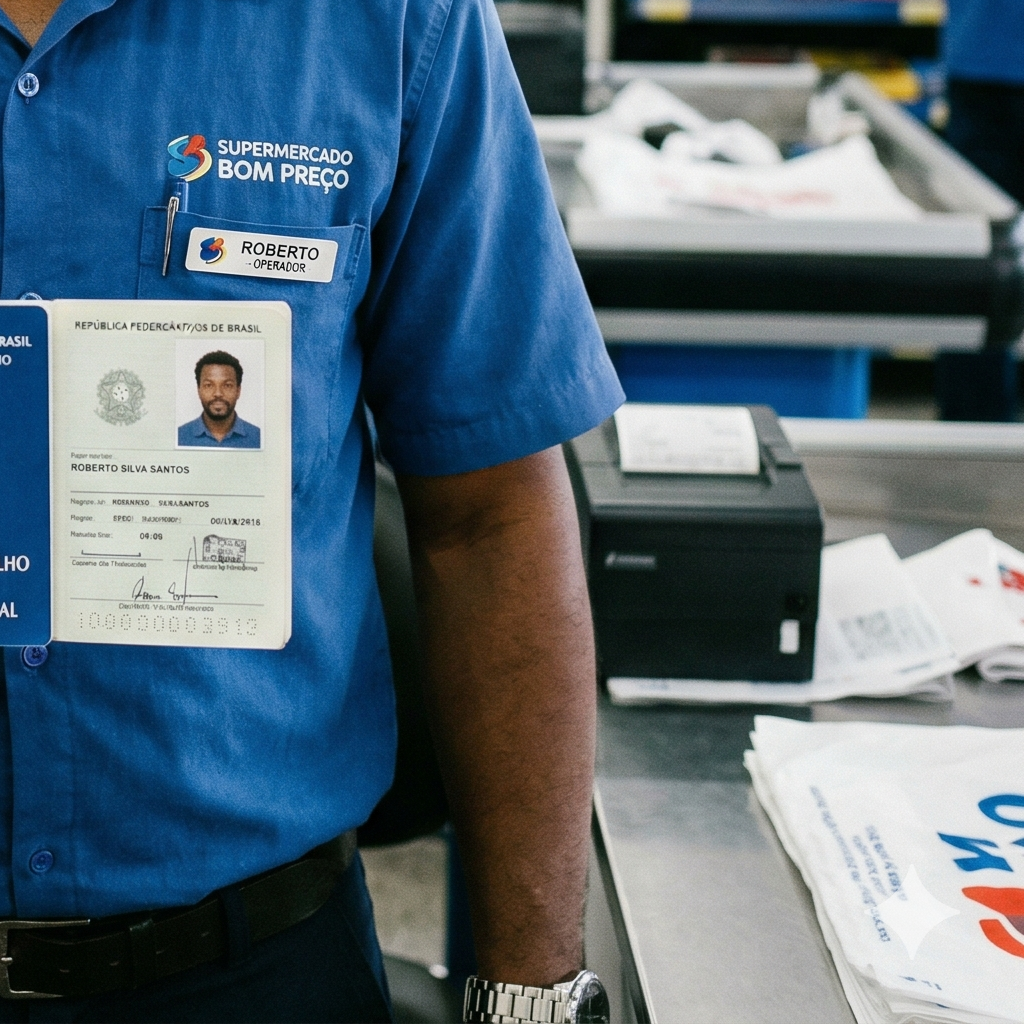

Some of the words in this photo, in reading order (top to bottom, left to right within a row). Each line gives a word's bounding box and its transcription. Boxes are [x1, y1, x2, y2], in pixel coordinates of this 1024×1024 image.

[217, 139, 354, 166] SUPERMERCADO
[218, 159, 275, 182] BOM
[280, 163, 350, 195] PREÇO
[241, 240, 320, 261] ROBERTO
[253, 259, 306, 273] OPERADOR
[211, 323, 224, 333] DE
[227, 324, 262, 334] BRASIL
[70, 463, 119, 473] ROBERTO
[121, 464, 148, 473] SILVA
[149, 465, 190, 474] SANTOS
